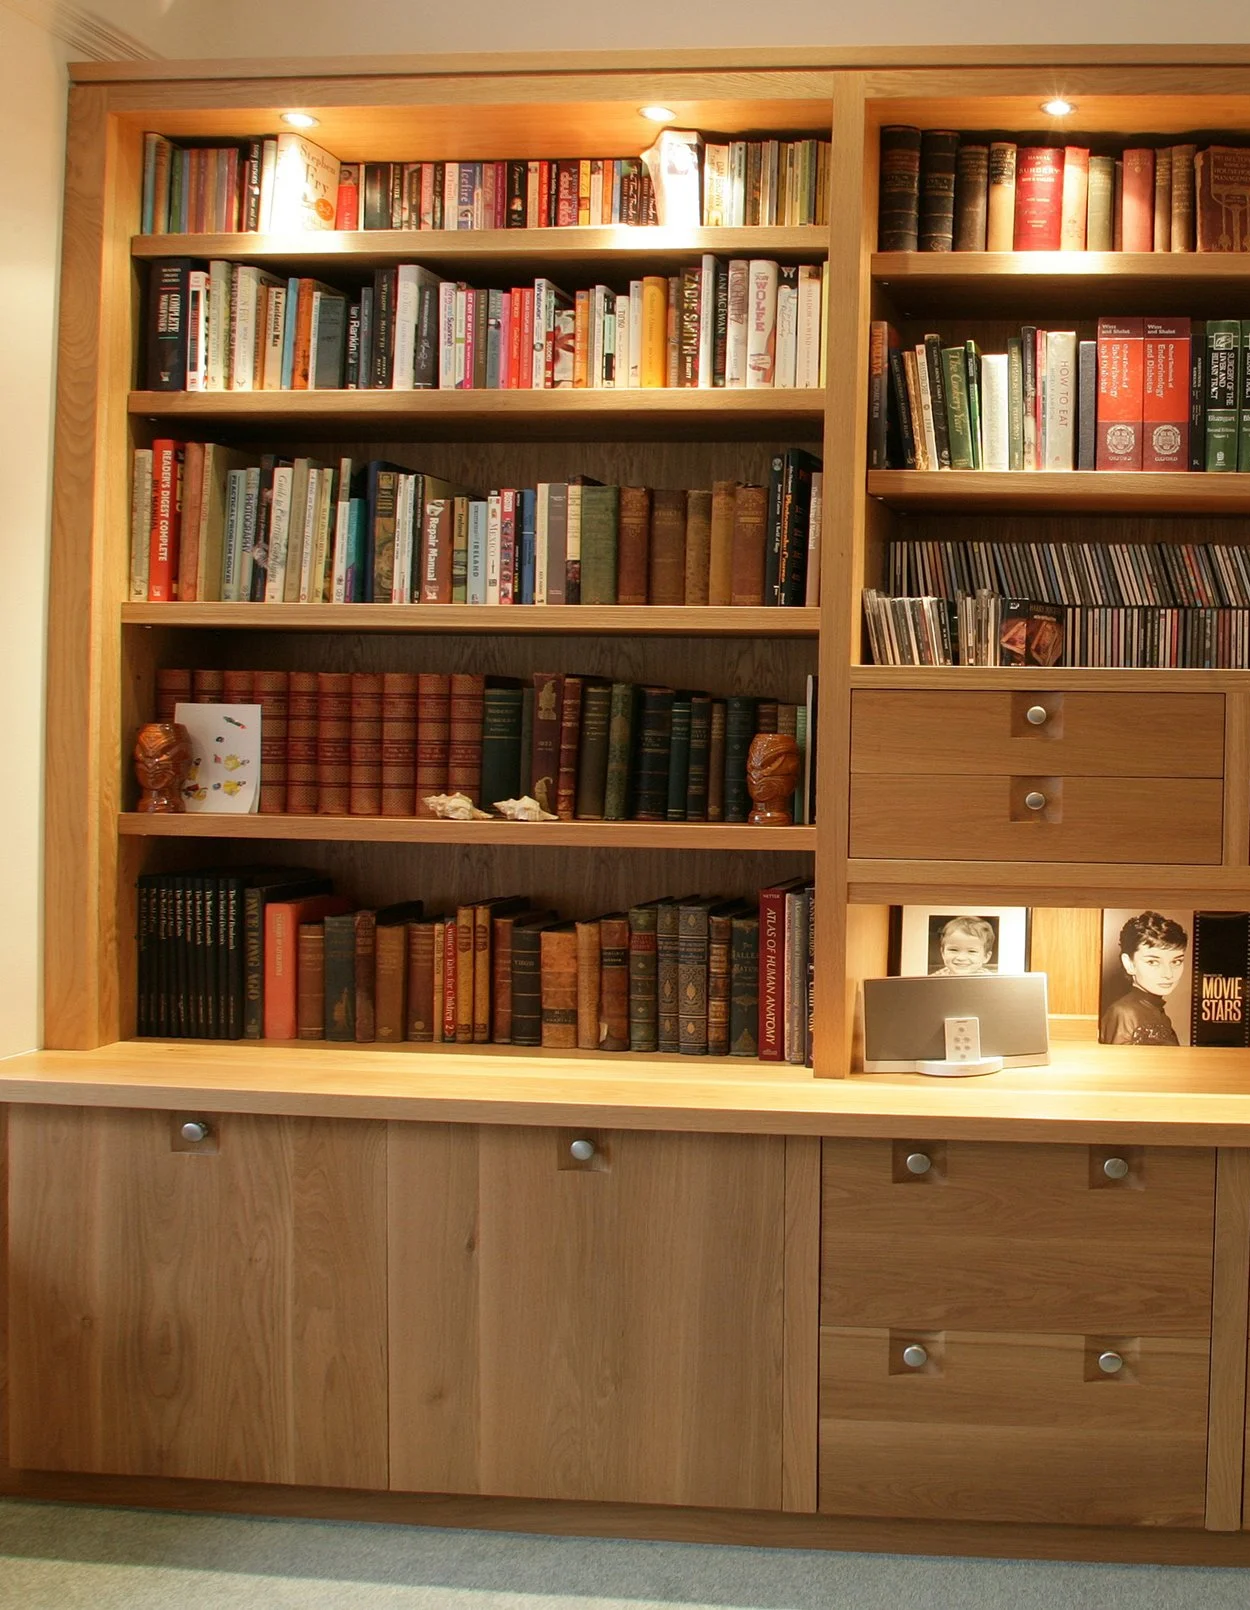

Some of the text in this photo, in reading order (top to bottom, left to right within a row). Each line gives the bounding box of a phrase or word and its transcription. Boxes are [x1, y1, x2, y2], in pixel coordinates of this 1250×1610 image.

[300, 143, 336, 176] Stephen
[306, 163, 330, 197] Fry
[460, 168, 472, 202] Icefire
[719, 272, 727, 290] IAN
[730, 267, 745, 325] AUSCHWITZ
[168, 294, 180, 333] COMPLETE
[349, 306, 360, 351] Ian Rankin
[682, 273, 700, 354] ZADIE SMITH
[272, 334, 281, 348] Man
[872, 328, 883, 376] HIMALAYA
[1146, 360, 1154, 394] Diabetes
[1157, 344, 1166, 398] Endocrinology
[1211, 378, 1219, 400] TRACT
[1226, 352, 1235, 406] SURGERY OF THE
[949, 352, 964, 435] The Cookery Year
[1059, 361, 1069, 427] HOW TO EAT
[229, 475, 237, 518] PRACTICAL
[277, 475, 288, 497] Guide
[151, 479, 160, 531] DIY MANUAL
[158, 450, 172, 561] READER'S DIGEST COMPLETE
[226, 519, 235, 555] PROBLEM
[242, 493, 255, 554] PHOTOGRAPHY
[489, 523, 499, 557] MEXICO
[426, 518, 440, 581] Repair Manual
[472, 541, 480, 577] IRELAND
[446, 927, 456, 956] Winter's
[446, 959, 456, 976] Tales
[446, 978, 456, 989] for
[766, 908, 776, 1045] ATLAS OF HUMAN ANATOMY
[247, 972, 260, 1001] AGO
[1202, 977, 1243, 1000] MOVIE
[445, 990, 455, 1021] Children
[1201, 999, 1242, 1022] STARS
